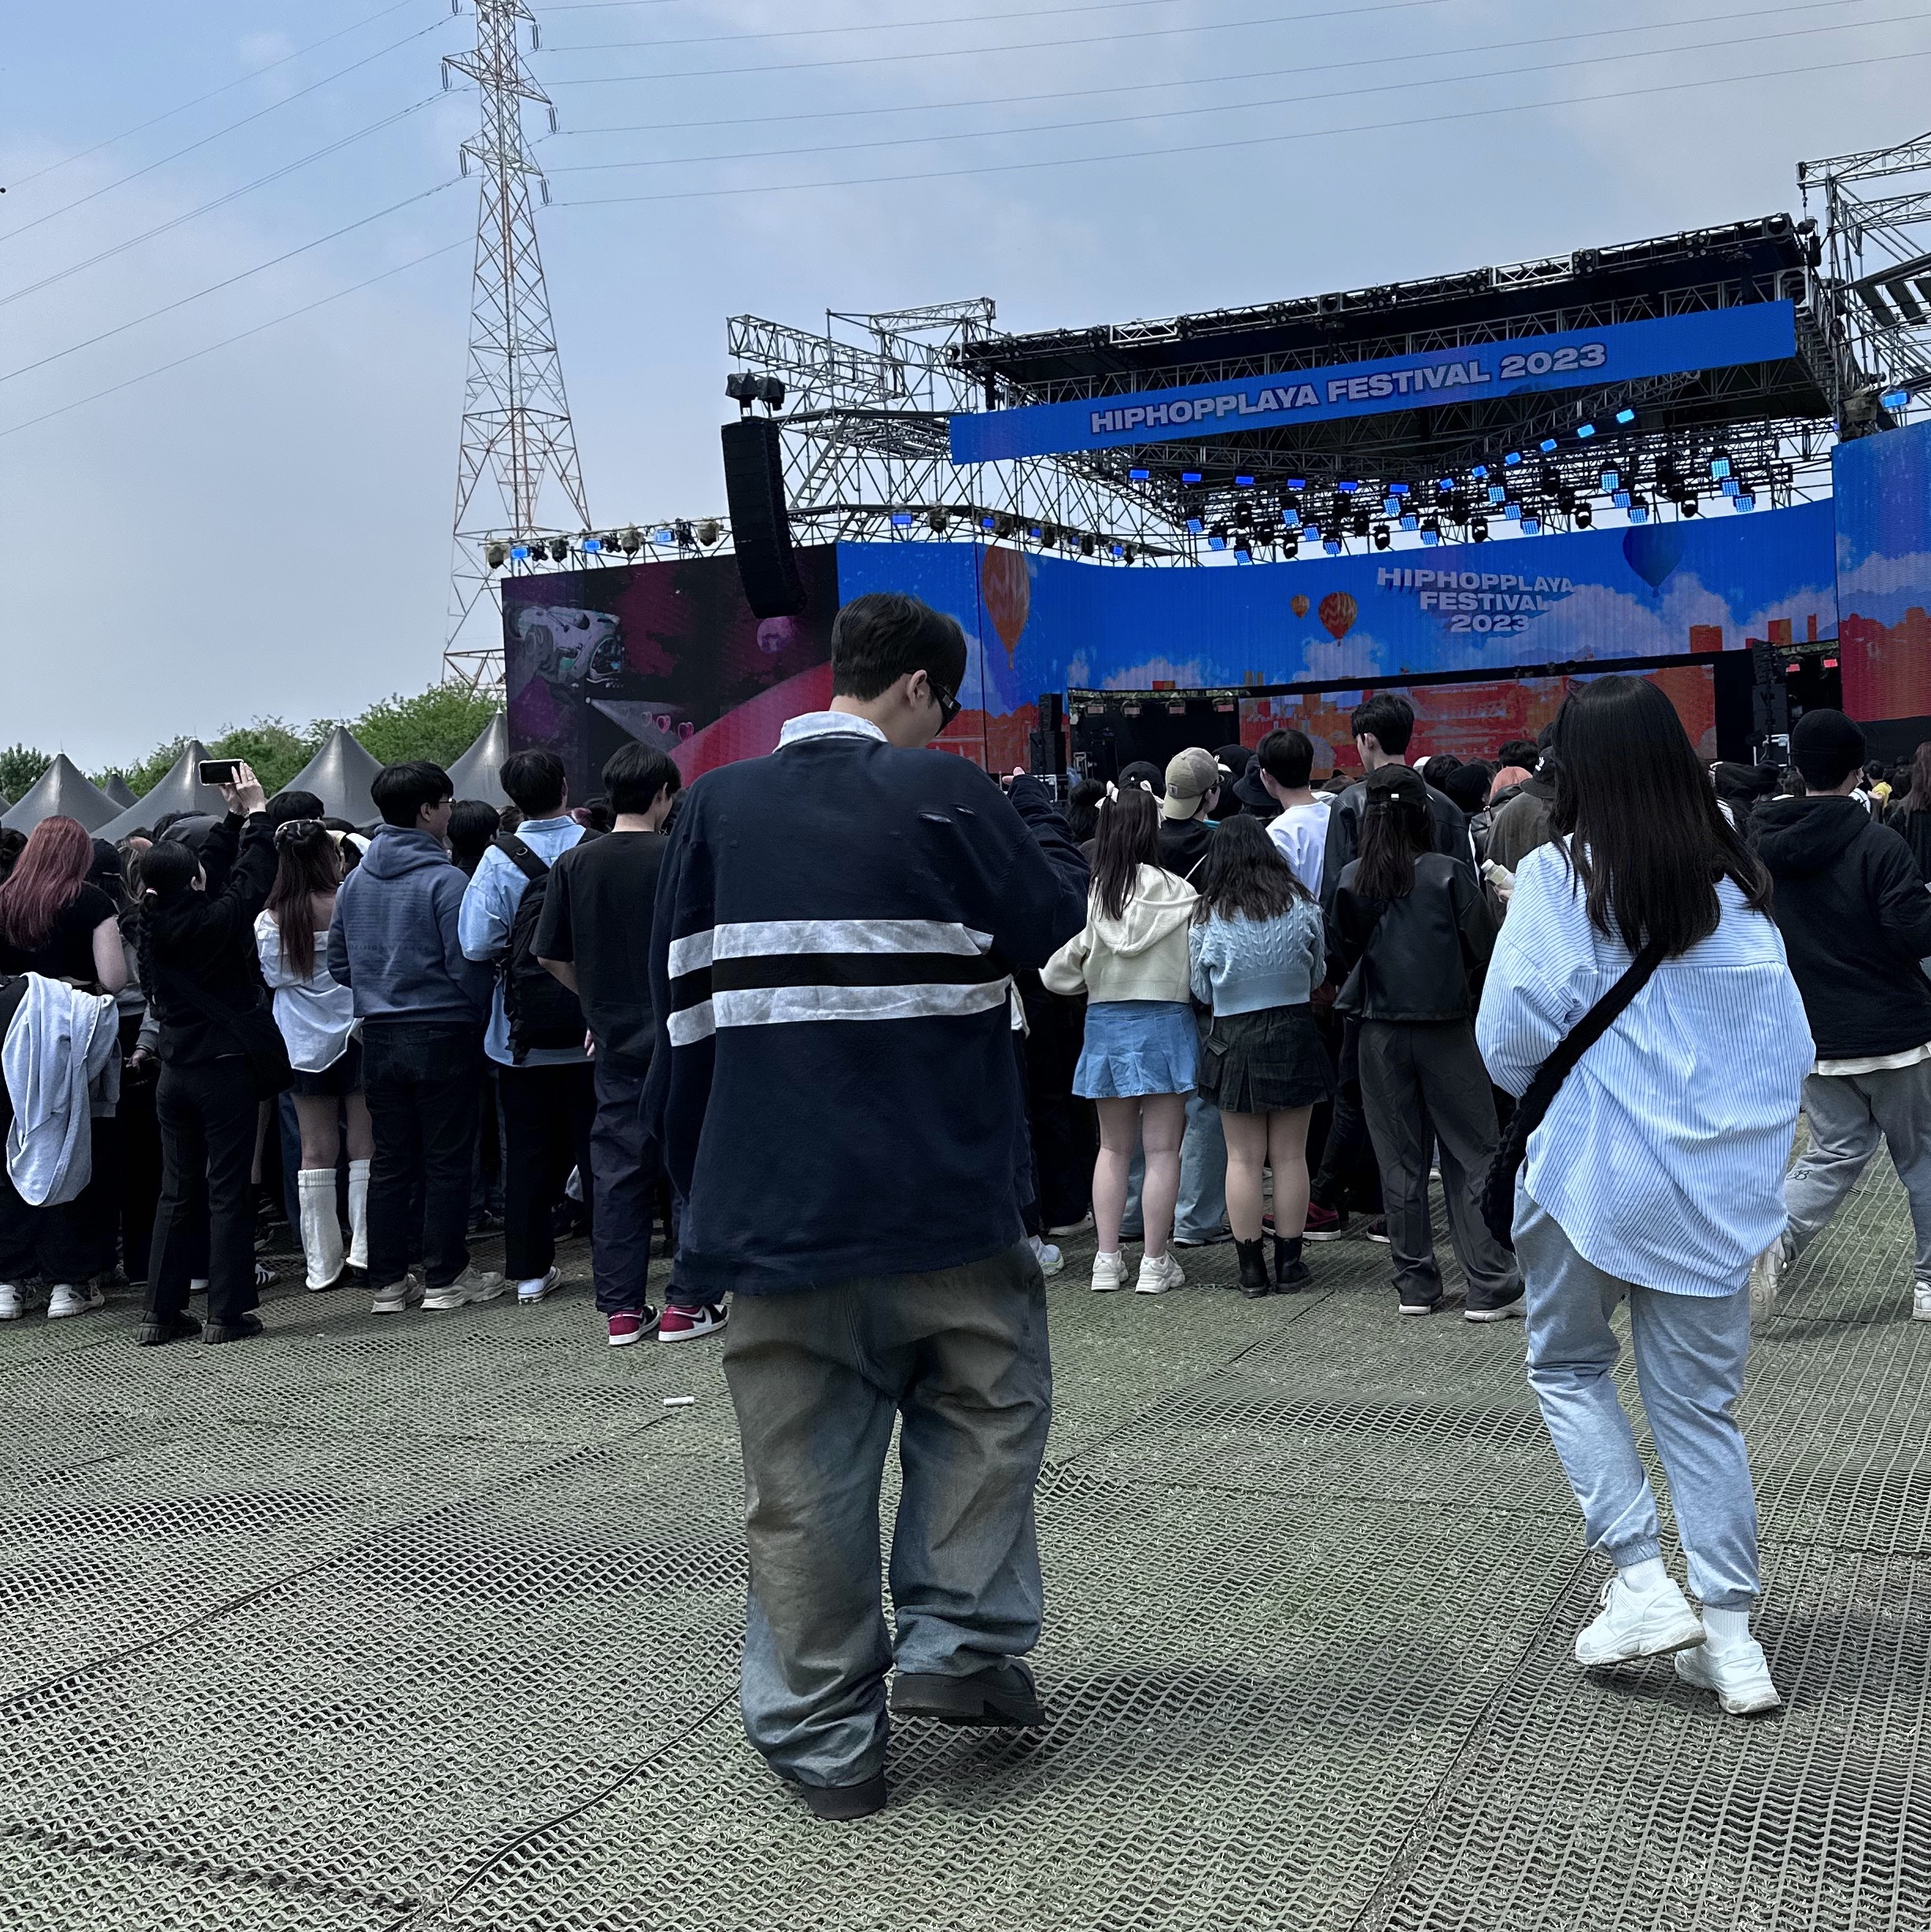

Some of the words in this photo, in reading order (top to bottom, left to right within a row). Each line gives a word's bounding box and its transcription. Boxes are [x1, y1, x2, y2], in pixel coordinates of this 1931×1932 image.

[1090, 385, 1319, 433] HIPHOPPLAYA
[1327, 359, 1491, 403] FESTIVAL
[1501, 344, 1607, 378] 2023
[1377, 566, 1573, 592] HIPHOPPLAYA
[1419, 592, 1551, 611] FESTIVAL
[1450, 614, 1530, 633] 2023
